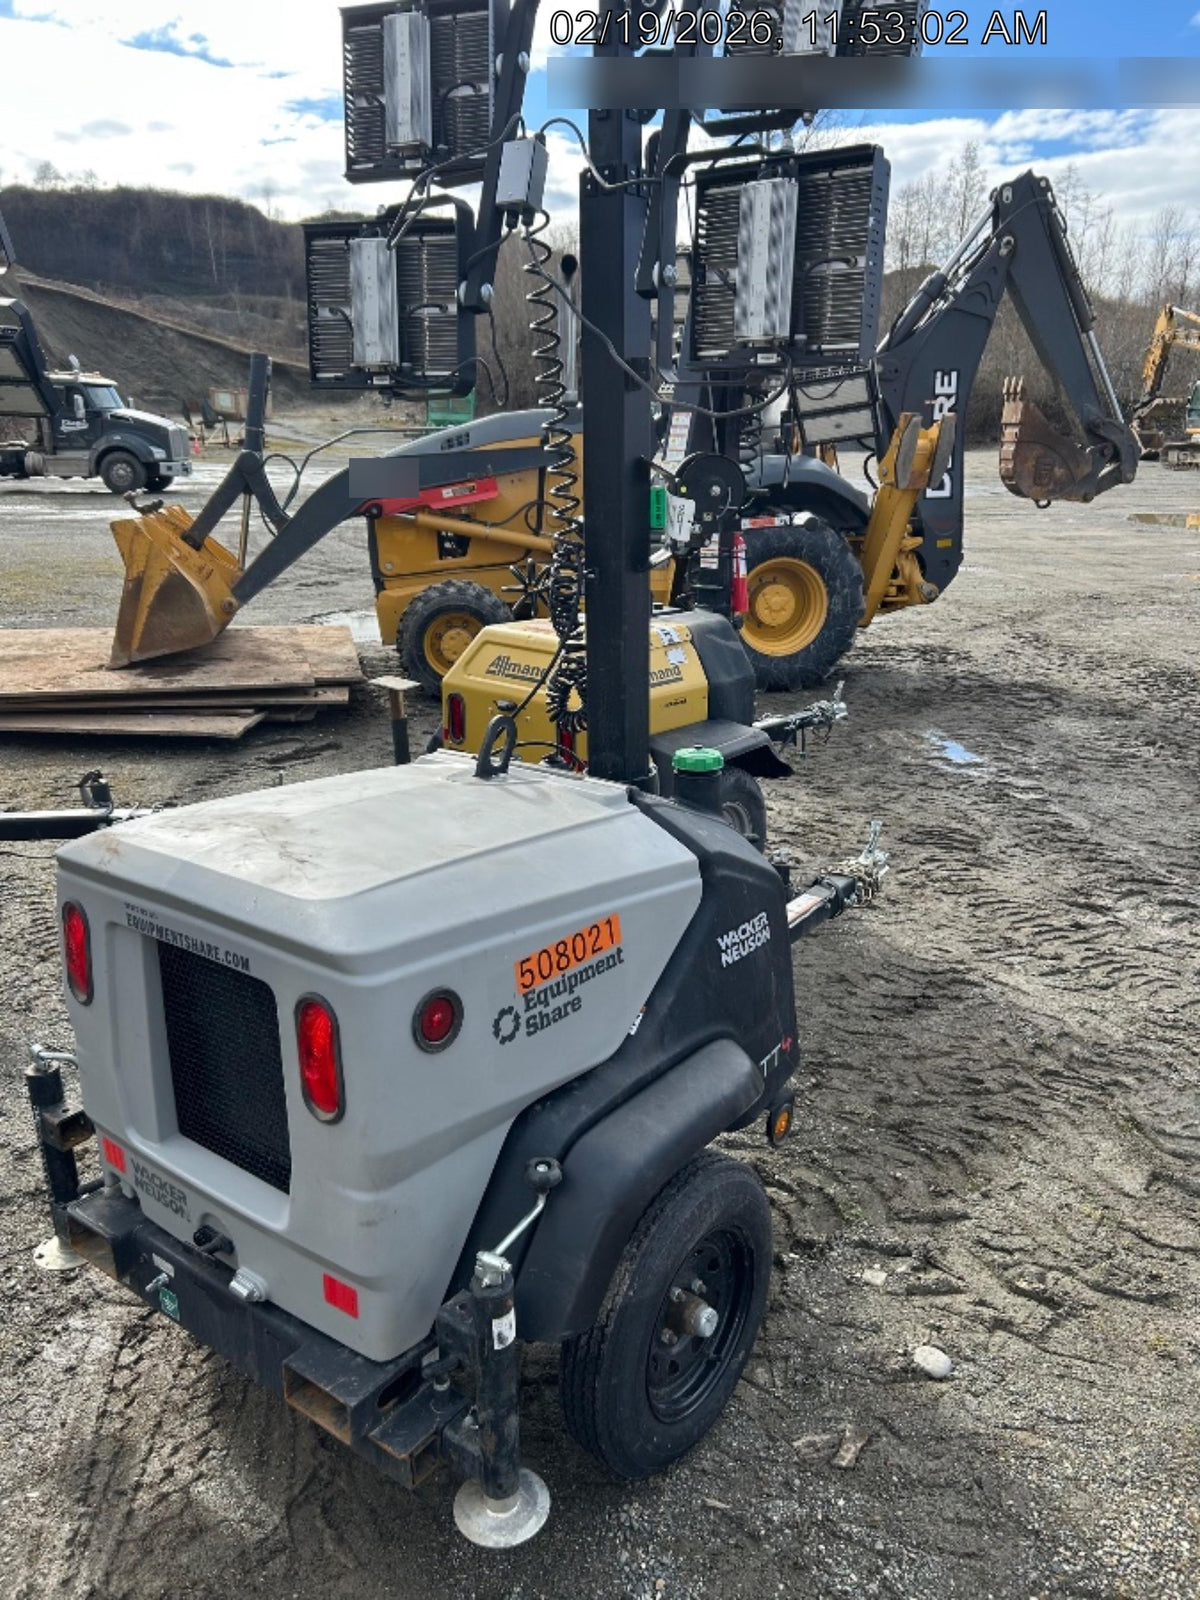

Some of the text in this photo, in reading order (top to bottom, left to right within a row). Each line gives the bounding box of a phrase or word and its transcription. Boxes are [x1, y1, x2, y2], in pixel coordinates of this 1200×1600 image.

[519, 918, 616, 989] 508021
[716, 911, 769, 951] WACKER
[720, 926, 771, 968] NEUSON
[522, 946, 625, 1013] Equipment
[525, 995, 583, 1037] Share
[130, 1158, 188, 1206] WACKER
